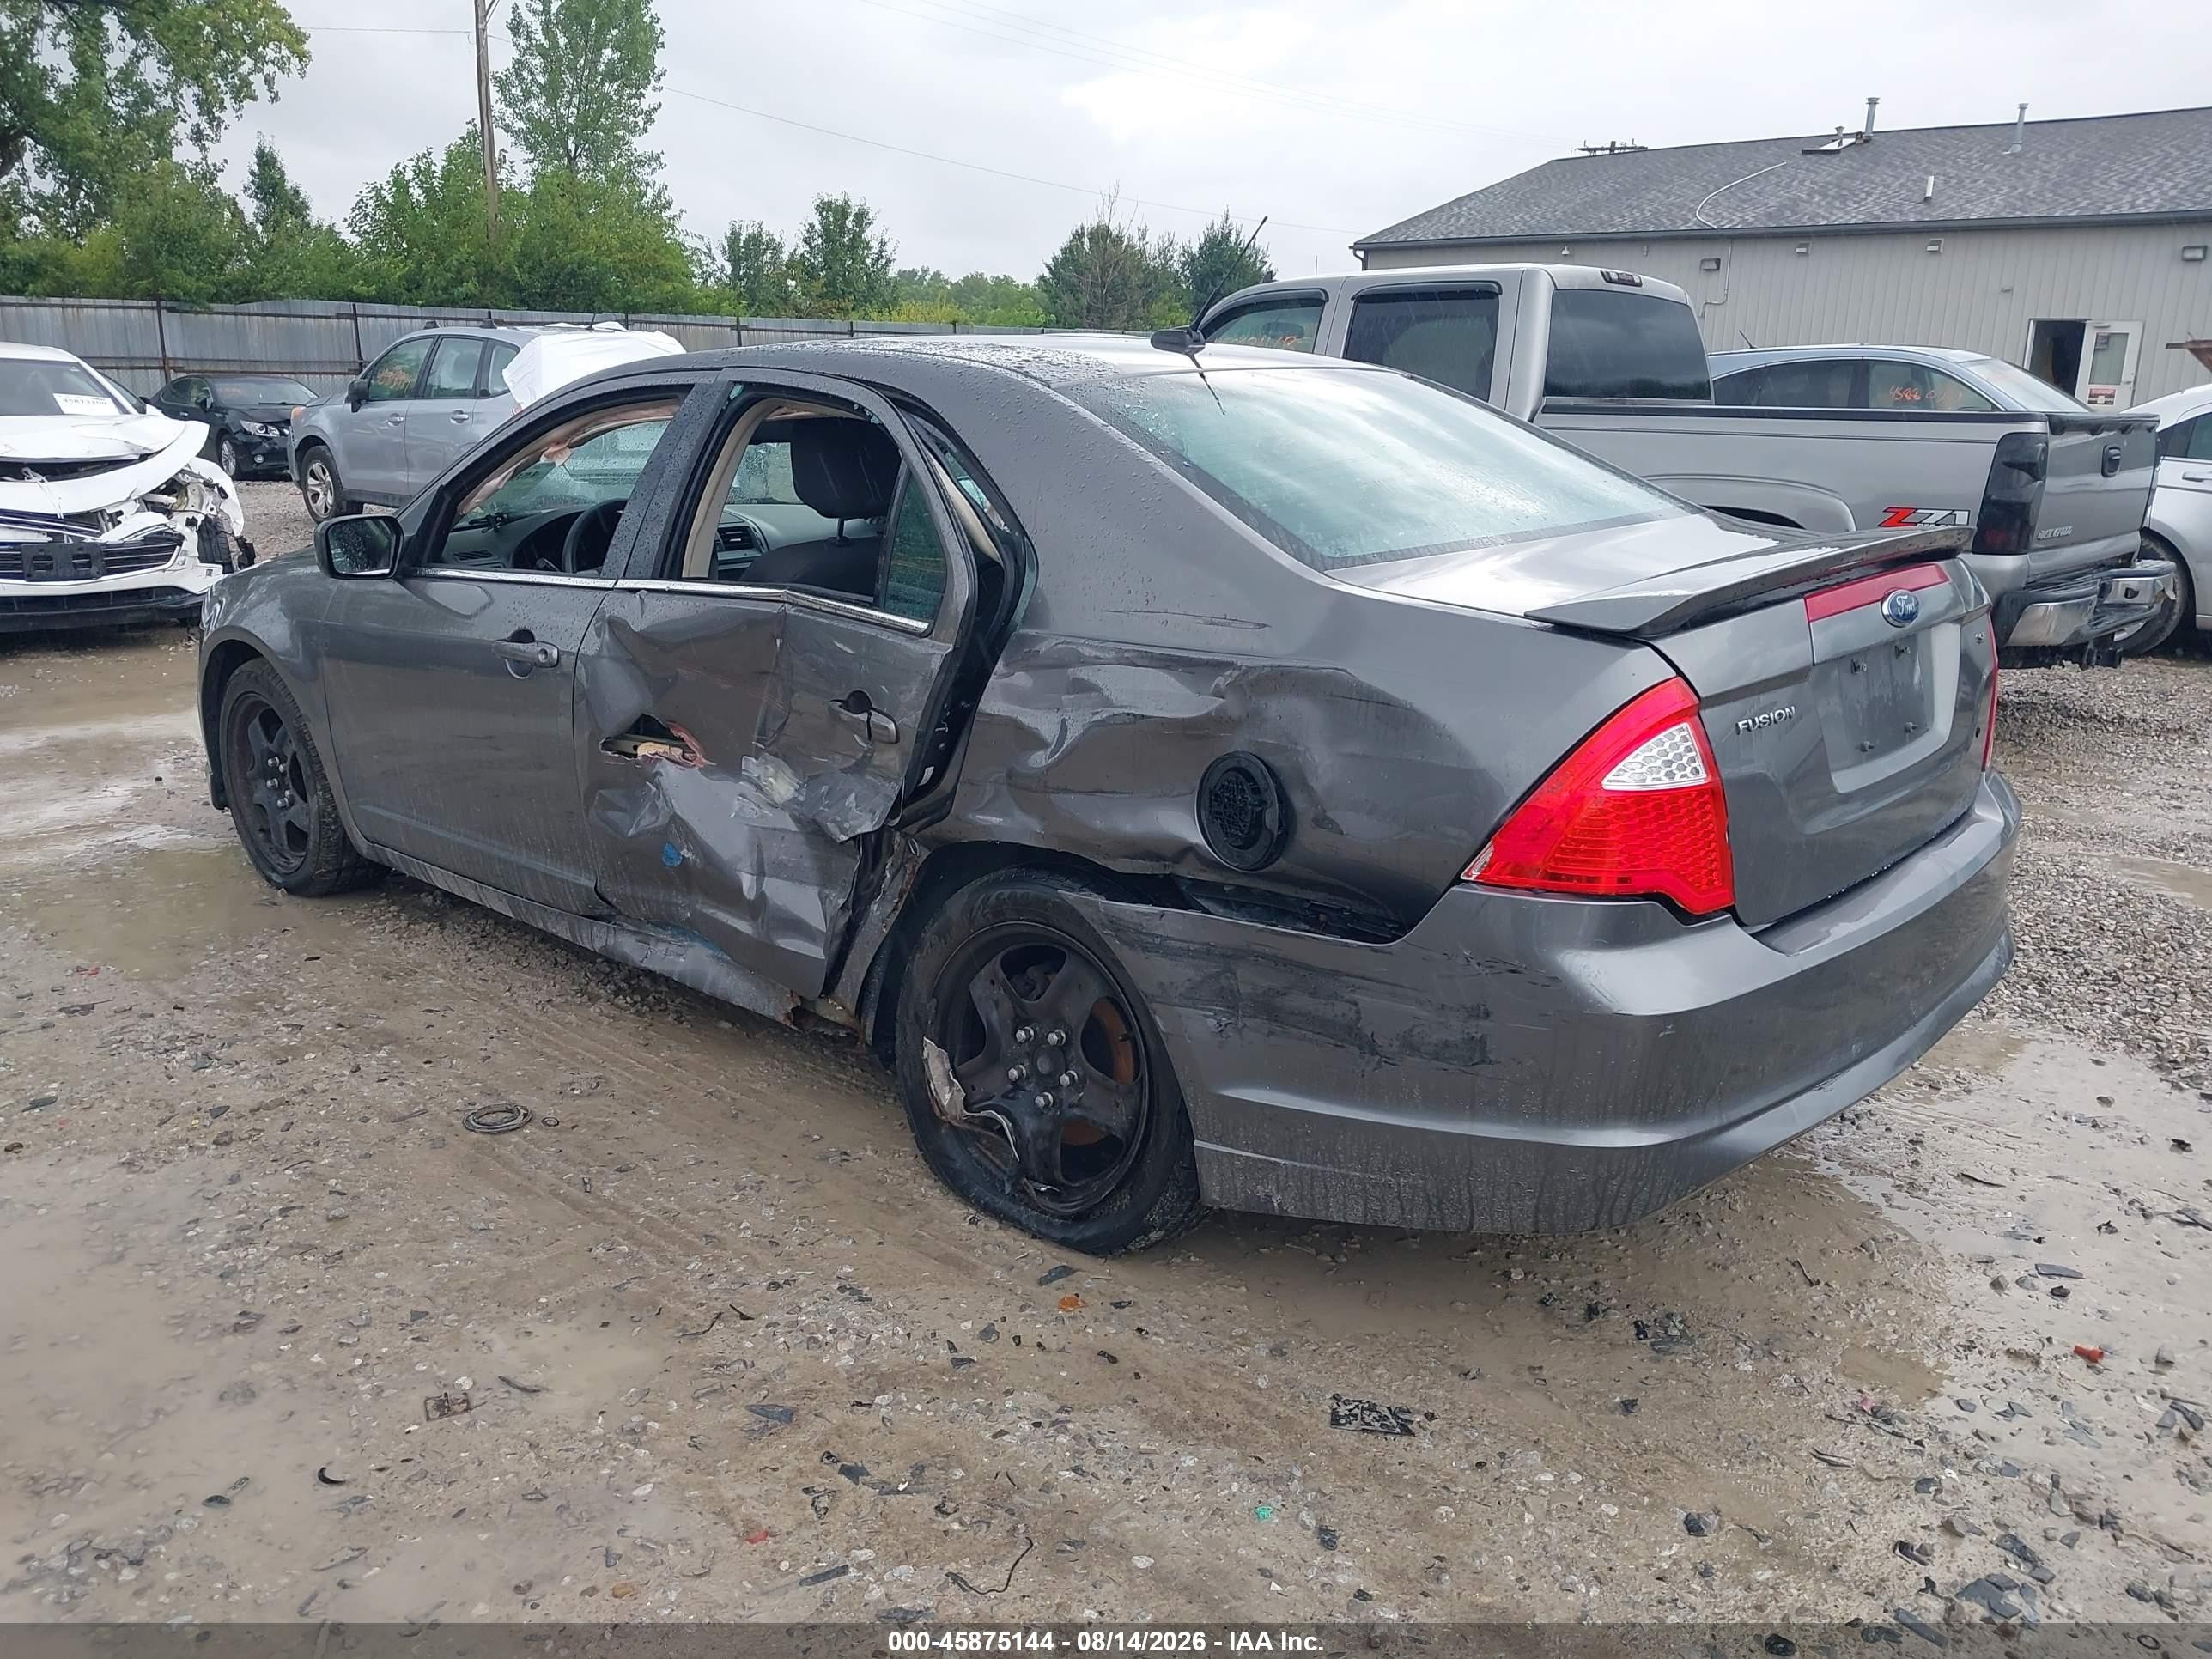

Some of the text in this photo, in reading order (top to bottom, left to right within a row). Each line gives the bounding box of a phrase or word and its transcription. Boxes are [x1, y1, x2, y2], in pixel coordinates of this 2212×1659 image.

[1877, 507, 1971, 527] Z71
[1896, 594, 1916, 617] Ford
[1736, 705, 1796, 735] FUSION
